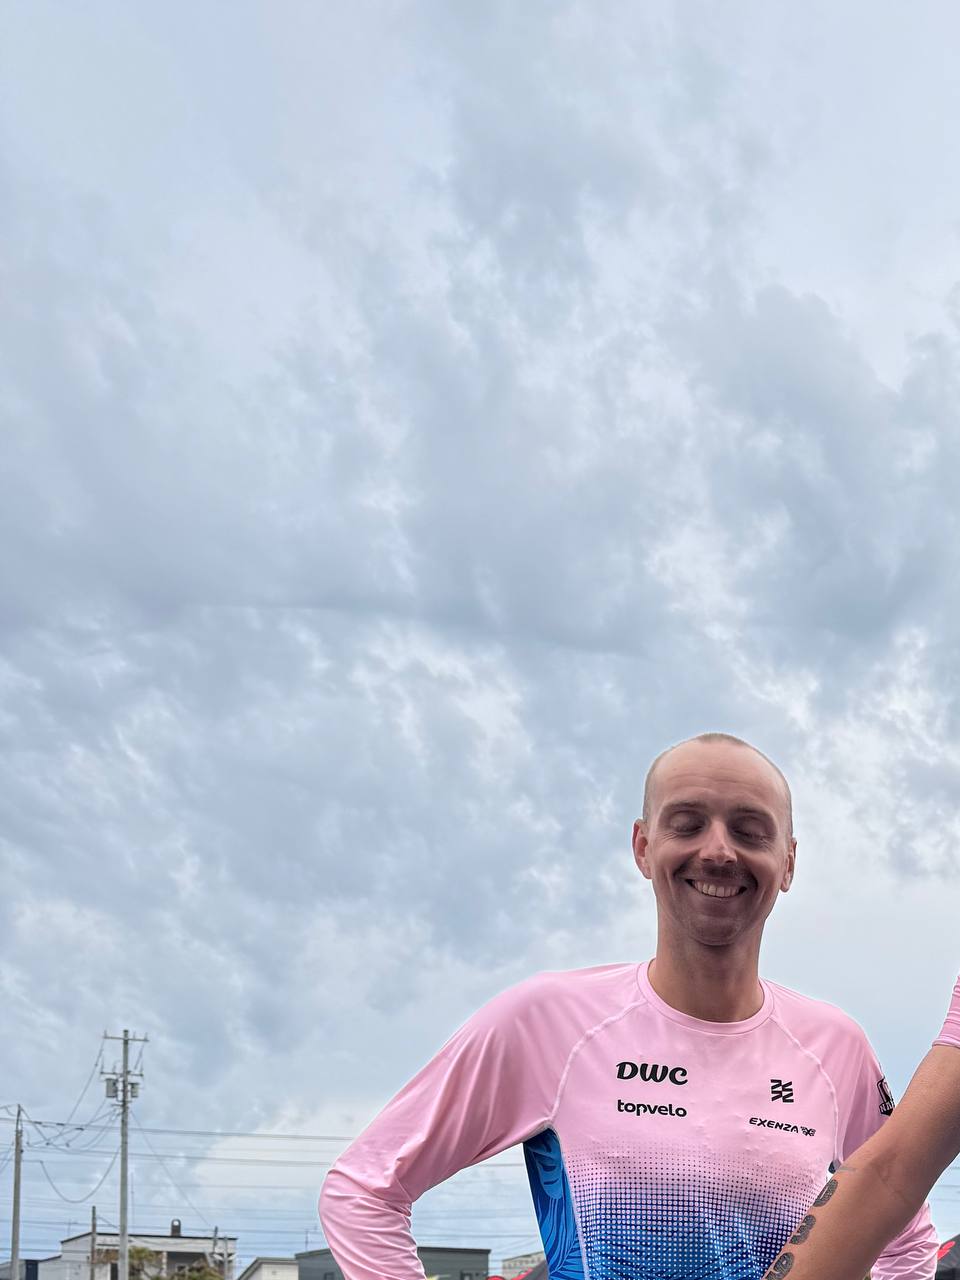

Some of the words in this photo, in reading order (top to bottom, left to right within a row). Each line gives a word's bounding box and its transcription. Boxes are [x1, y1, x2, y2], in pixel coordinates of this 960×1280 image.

[616, 1061, 688, 1086] DWC
[617, 1099, 687, 1117] topvelo
[749, 1117, 799, 1134] EXENZA
